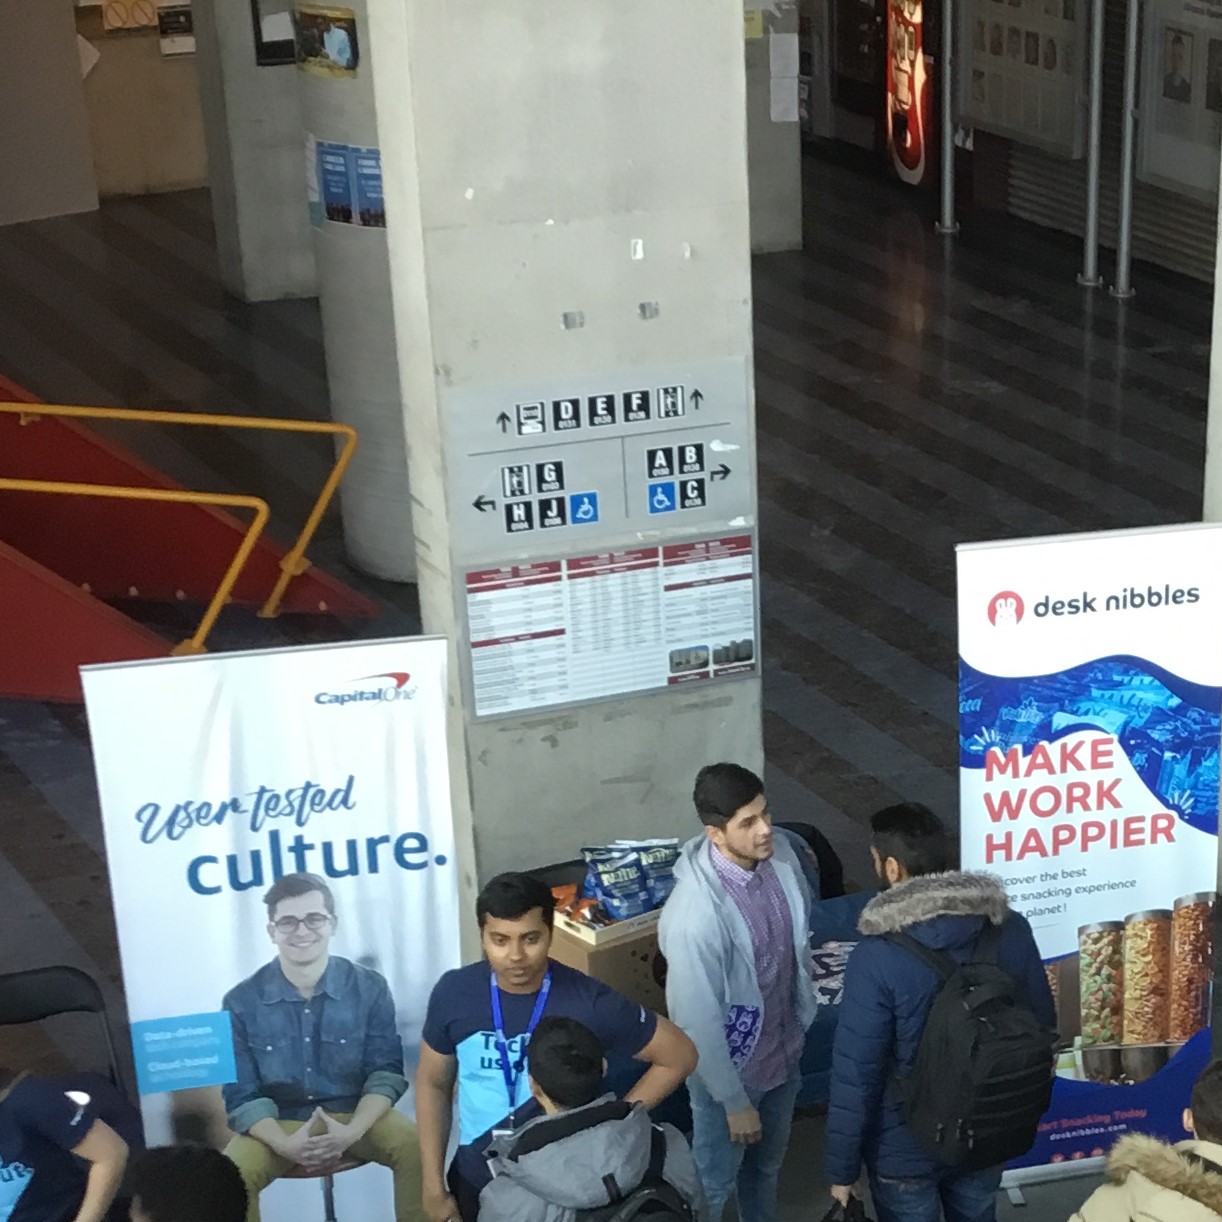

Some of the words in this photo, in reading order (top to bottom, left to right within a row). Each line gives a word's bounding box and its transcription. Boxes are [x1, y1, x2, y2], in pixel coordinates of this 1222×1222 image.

[560, 400, 573, 420] D
[596, 396, 608, 416] E
[631, 392, 643, 412] F
[653, 449, 667, 468] A
[684, 445, 698, 464] B
[543, 463, 556, 482] G
[686, 479, 699, 498] C
[512, 503, 526, 522] H
[546, 499, 558, 518] J
[1033, 591, 1098, 618] desk
[1105, 584, 1201, 613] nibbles
[984, 736, 1115, 782] MAKE
[982, 777, 1124, 823] WORK
[984, 812, 1177, 864] HAPPIER
[186, 828, 447, 896] culture.
[1040, 871, 1059, 883] the
[1061, 867, 1087, 879] best
[1021, 886, 1072, 902] snacking
[1075, 879, 1137, 895] experience
